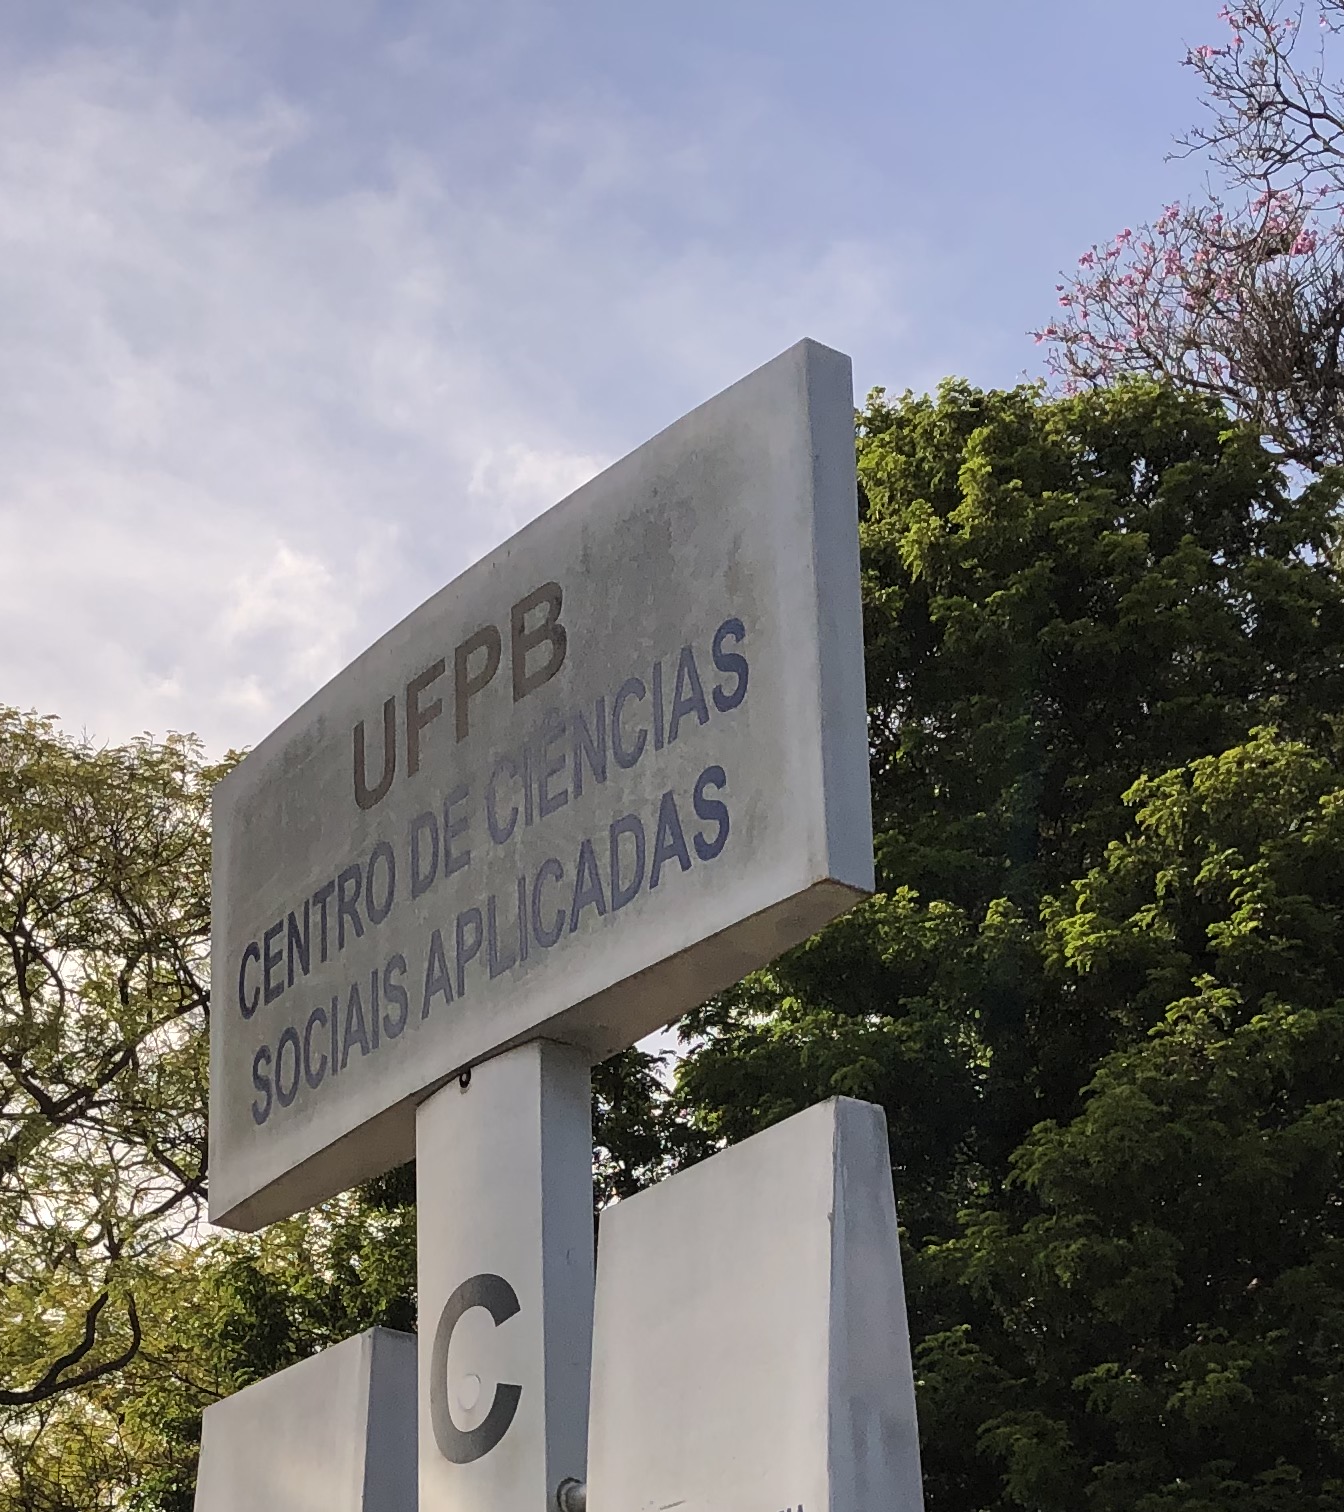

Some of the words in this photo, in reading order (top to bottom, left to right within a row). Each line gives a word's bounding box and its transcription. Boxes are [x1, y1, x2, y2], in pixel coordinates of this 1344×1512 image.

[351, 581, 568, 810] UFPB
[238, 840, 396, 1020] CENTRO
[410, 785, 471, 900] DE
[251, 953, 408, 1126] SOCIAIS
[421, 765, 731, 1021] APLICADAS
